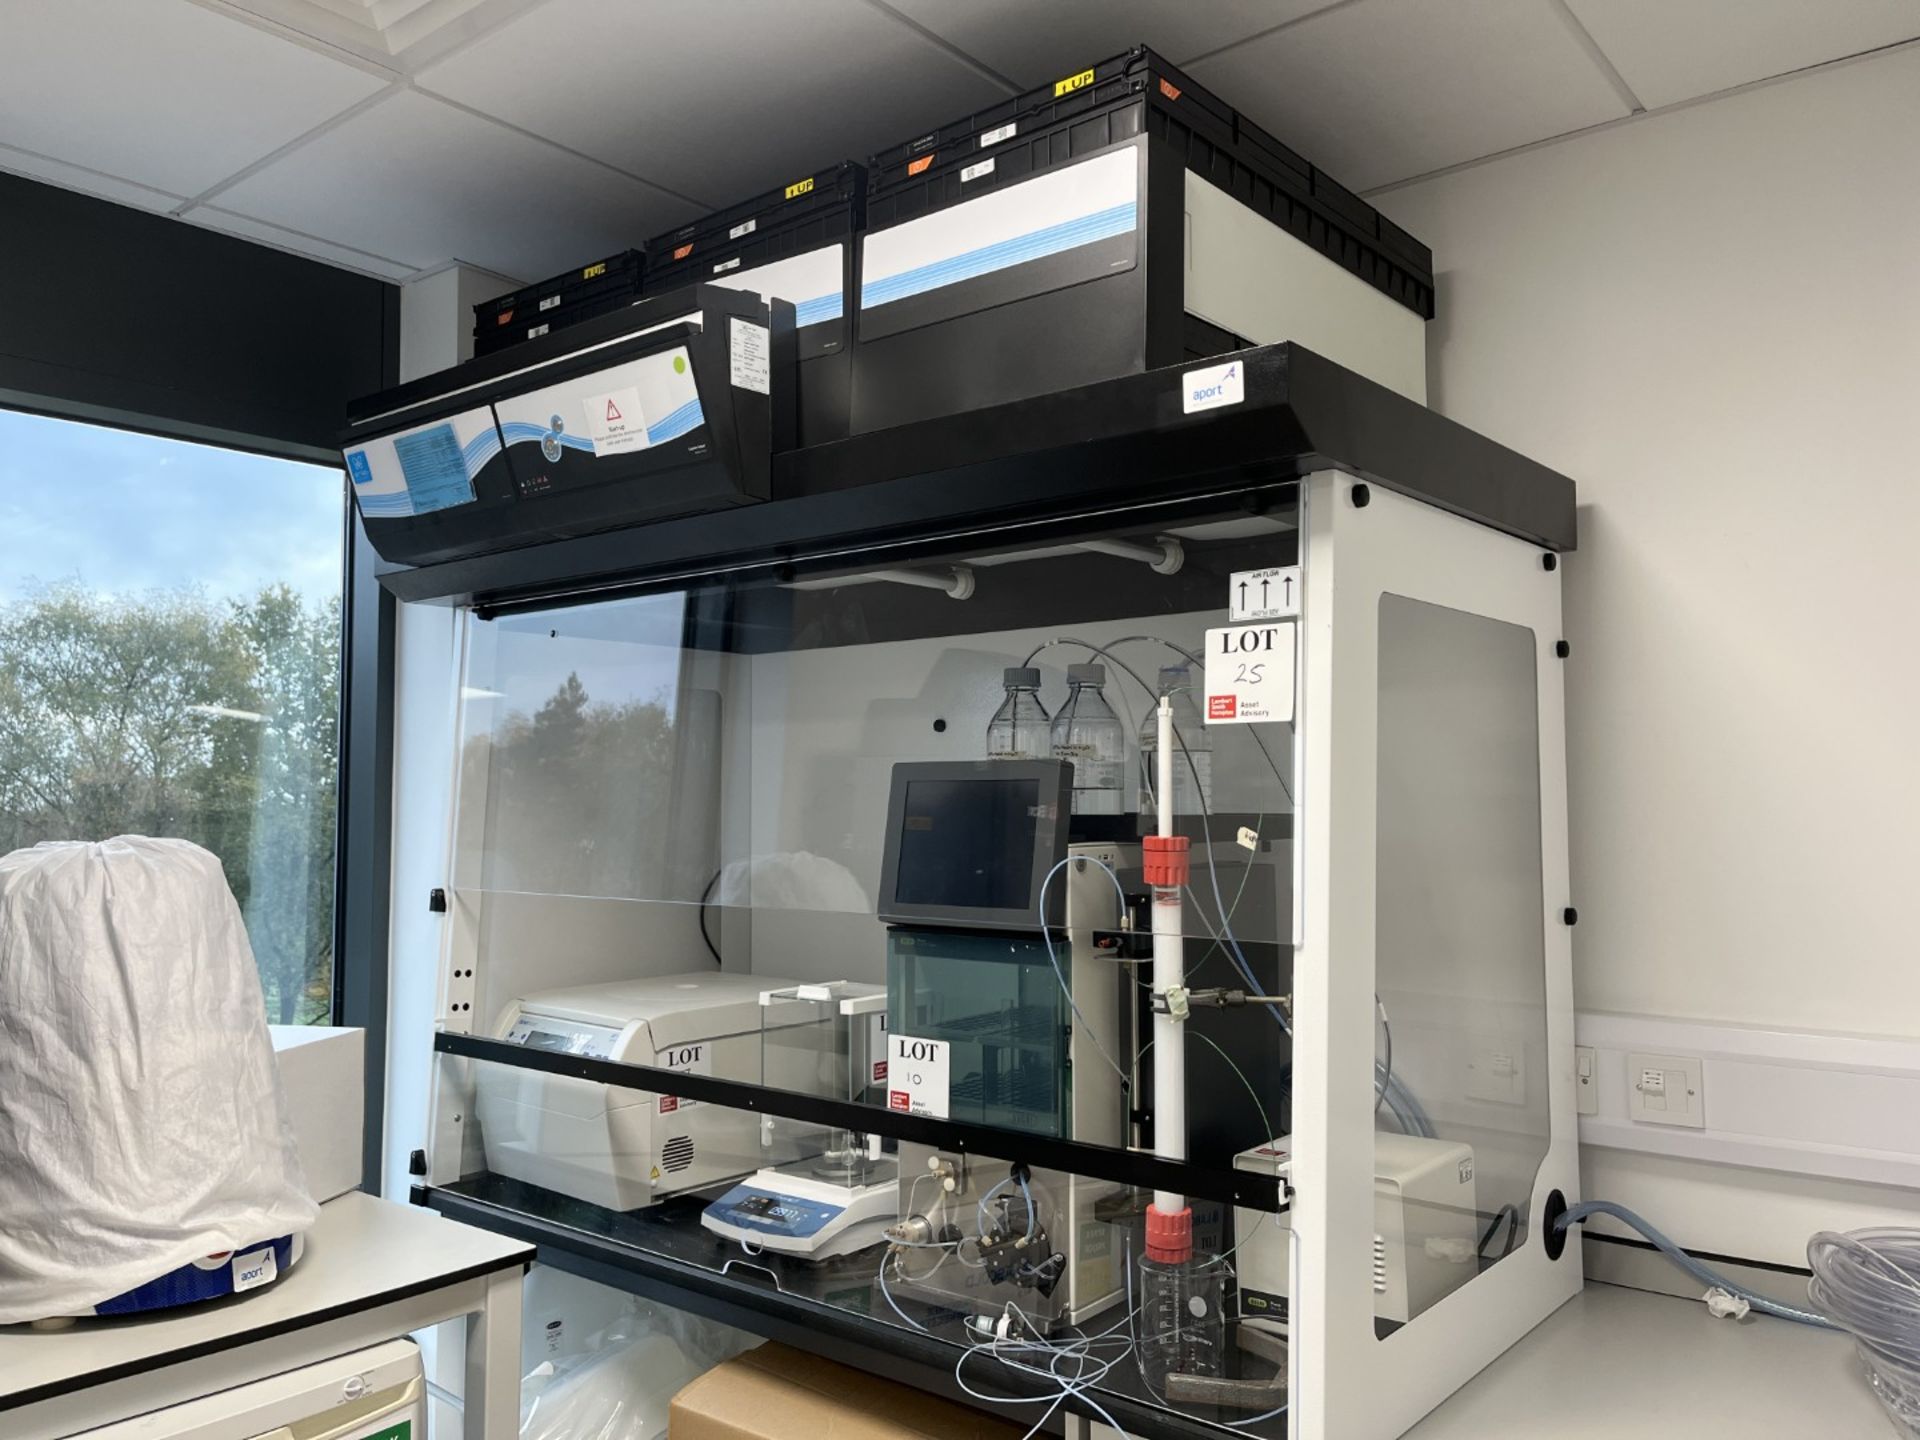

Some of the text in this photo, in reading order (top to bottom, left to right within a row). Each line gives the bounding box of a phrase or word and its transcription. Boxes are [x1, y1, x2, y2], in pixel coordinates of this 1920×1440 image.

[1071, 72, 1092, 88] UP
[1193, 385, 1222, 402] aport
[1221, 628, 1278, 654] LOT
[1233, 663, 1266, 684] 25
[668, 1046, 702, 1067] LOT
[900, 1039, 939, 1062] LOT
